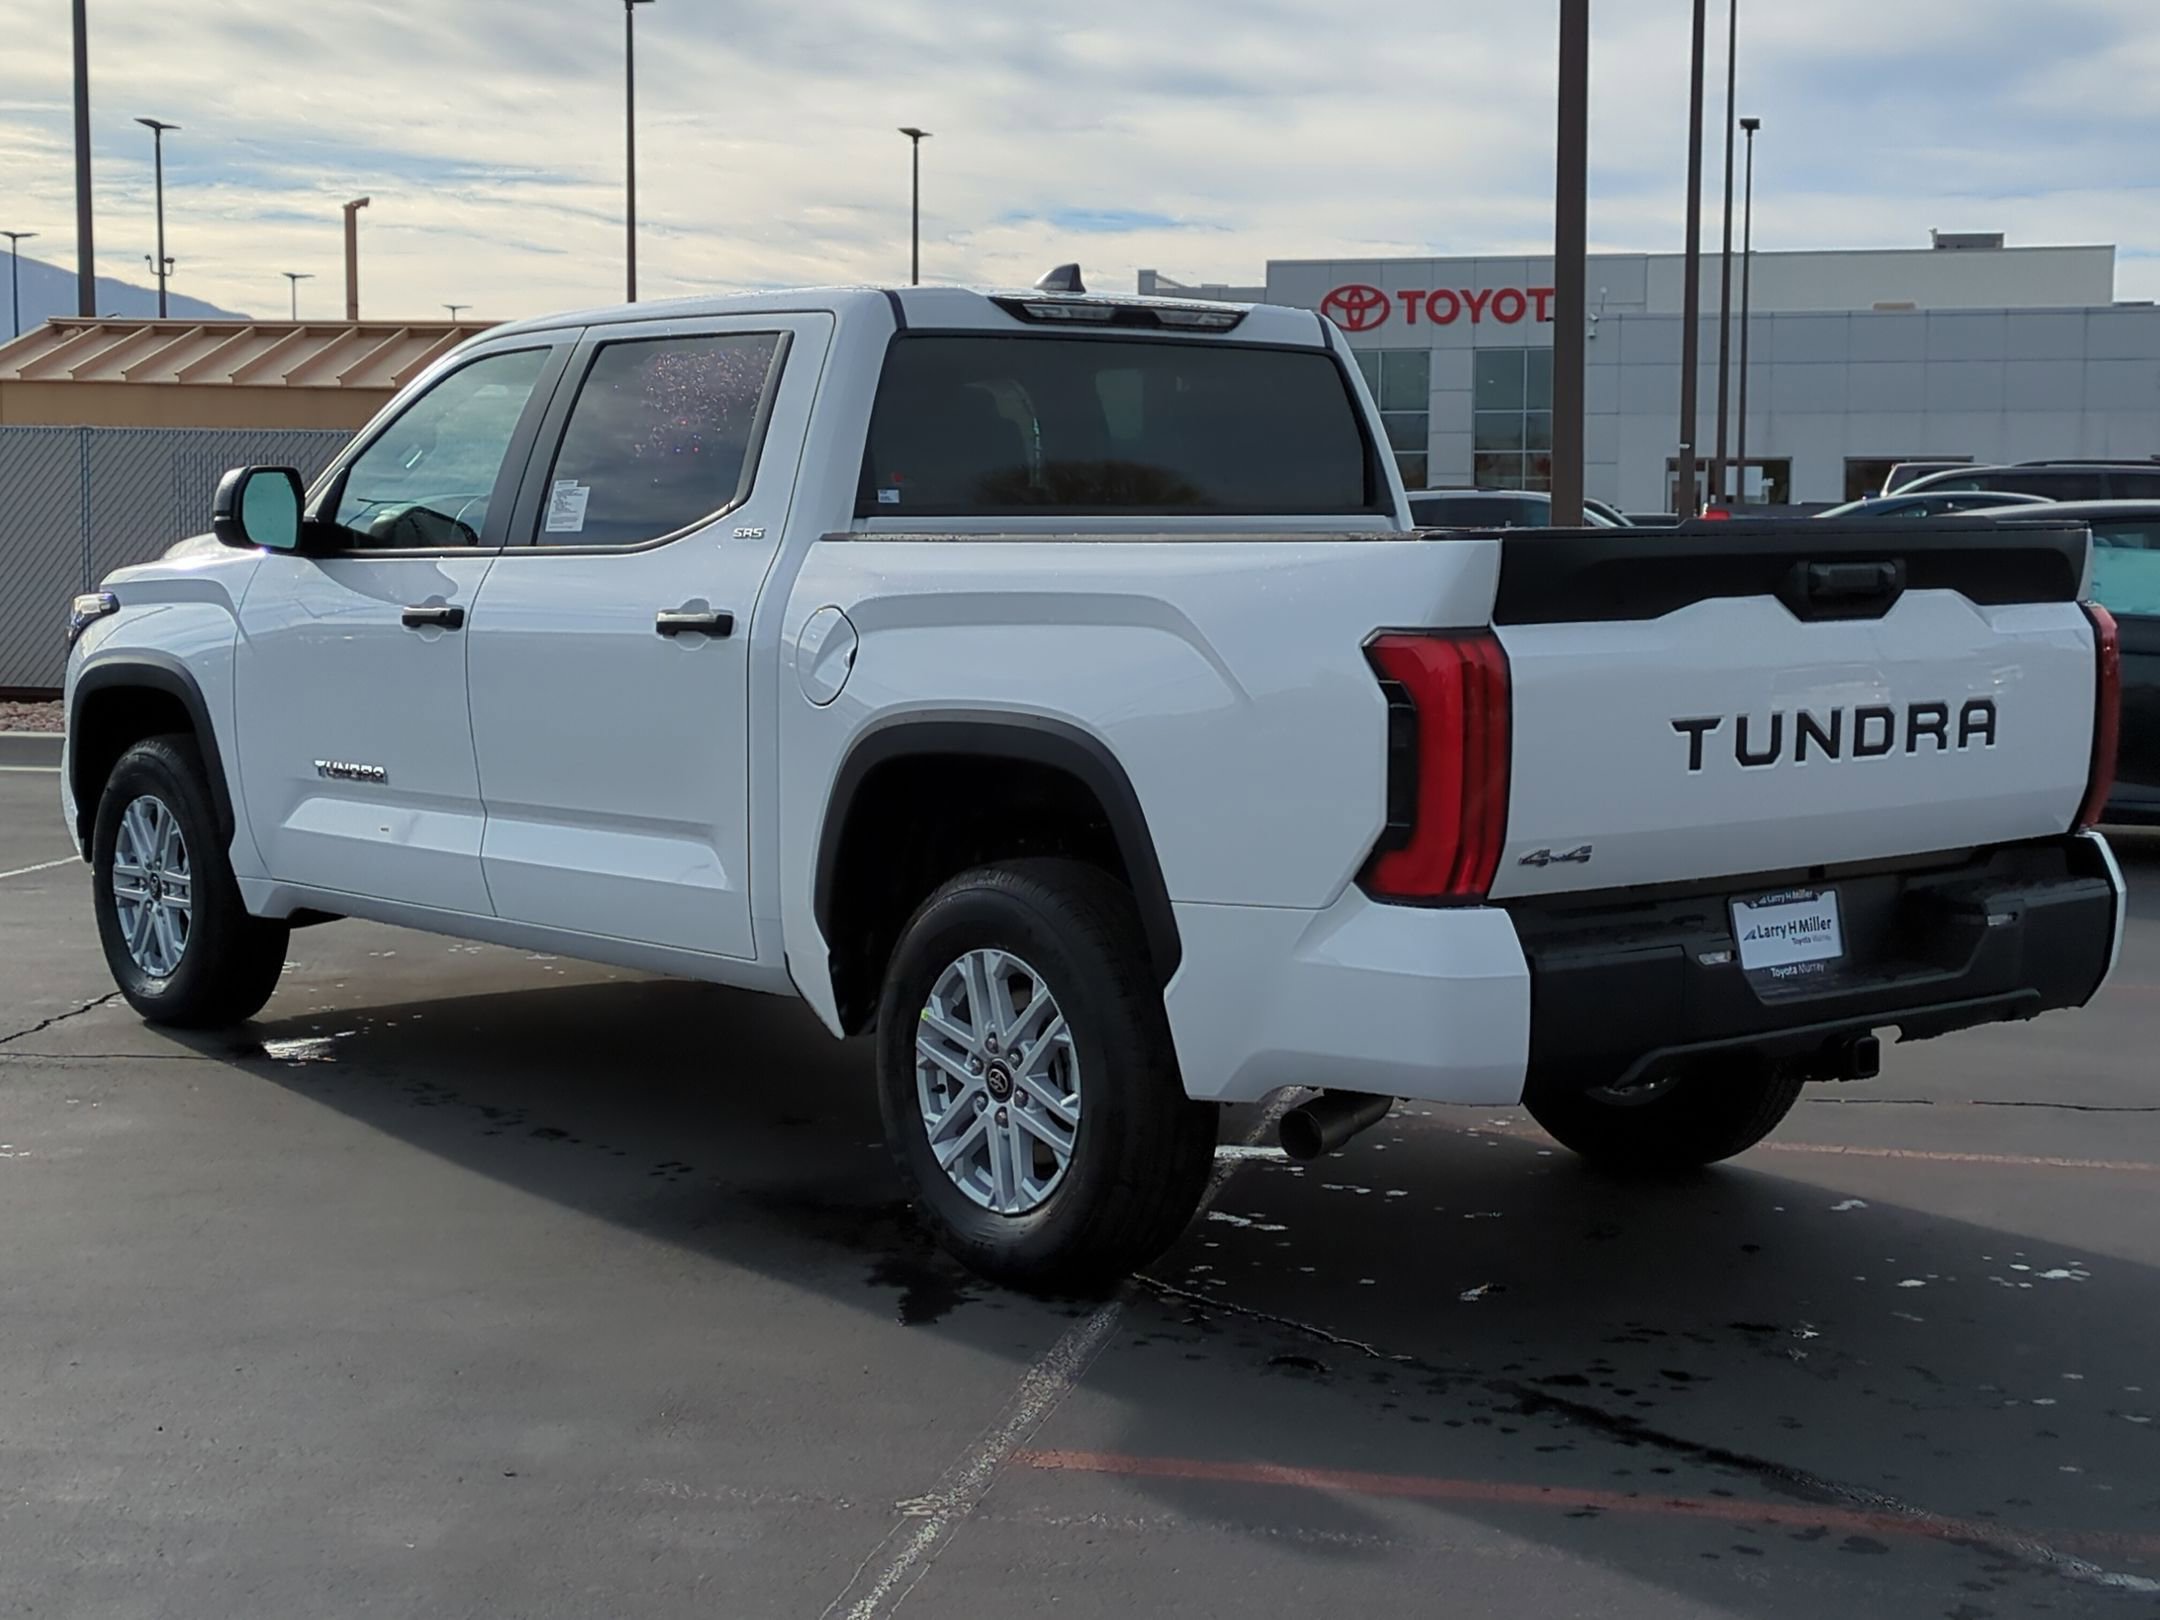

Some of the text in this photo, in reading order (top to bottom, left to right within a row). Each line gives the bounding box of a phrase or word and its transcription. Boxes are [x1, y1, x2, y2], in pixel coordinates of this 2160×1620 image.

[1397, 288, 1554, 324] TOYOT
[733, 527, 764, 539] SR5
[1671, 697, 1997, 773] TUNDRA
[314, 760, 388, 784] TUNDRA
[1757, 916, 1832, 940] Larry H Miller
[1770, 966, 1797, 978] Toyota
